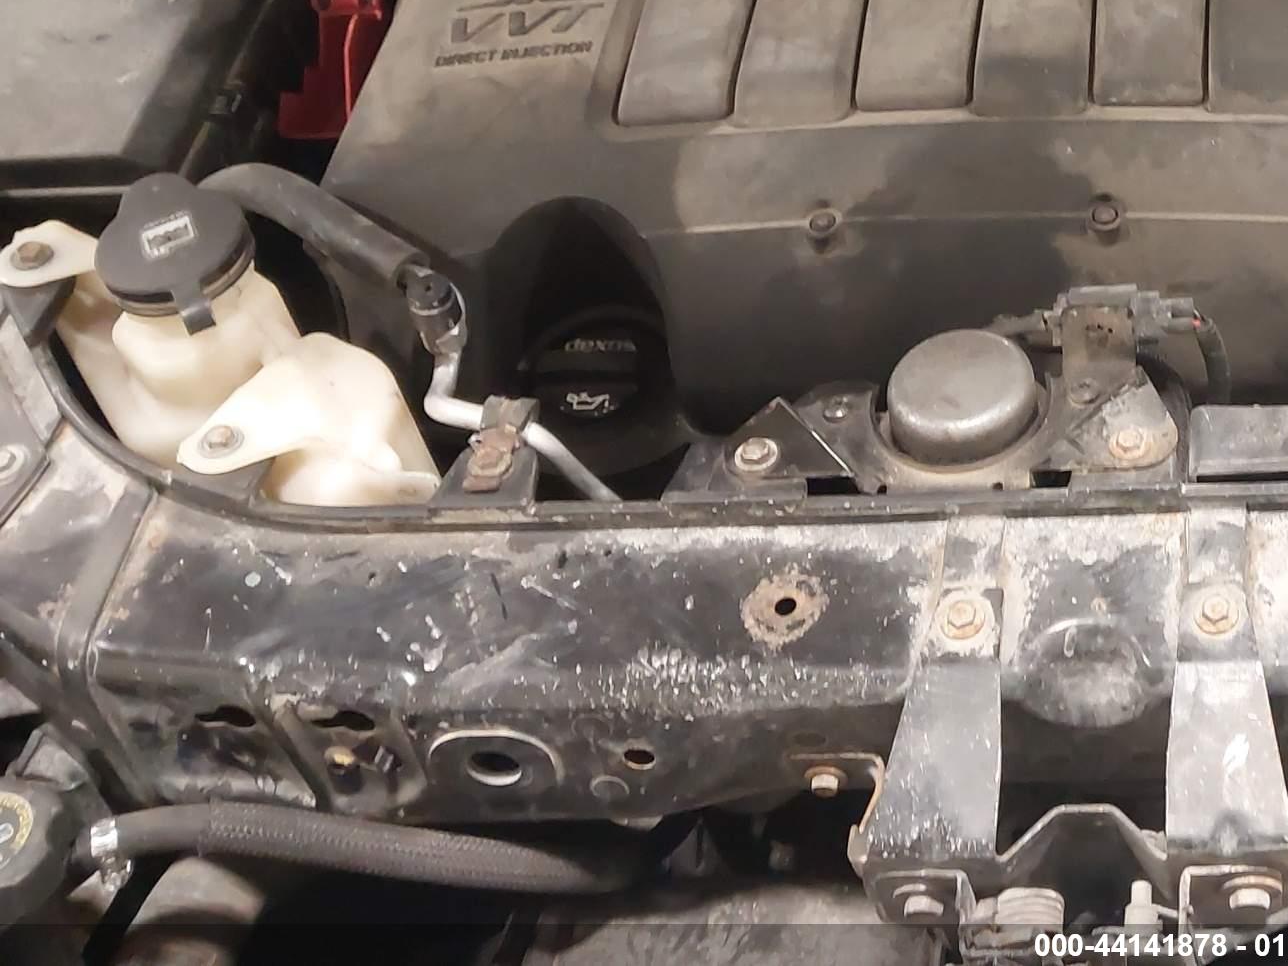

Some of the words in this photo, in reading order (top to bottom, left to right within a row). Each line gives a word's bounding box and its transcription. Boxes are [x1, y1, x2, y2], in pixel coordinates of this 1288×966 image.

[451, 2, 604, 44] VVT
[434, 48, 498, 68] DIRECT
[501, 40, 593, 61] INJECTION
